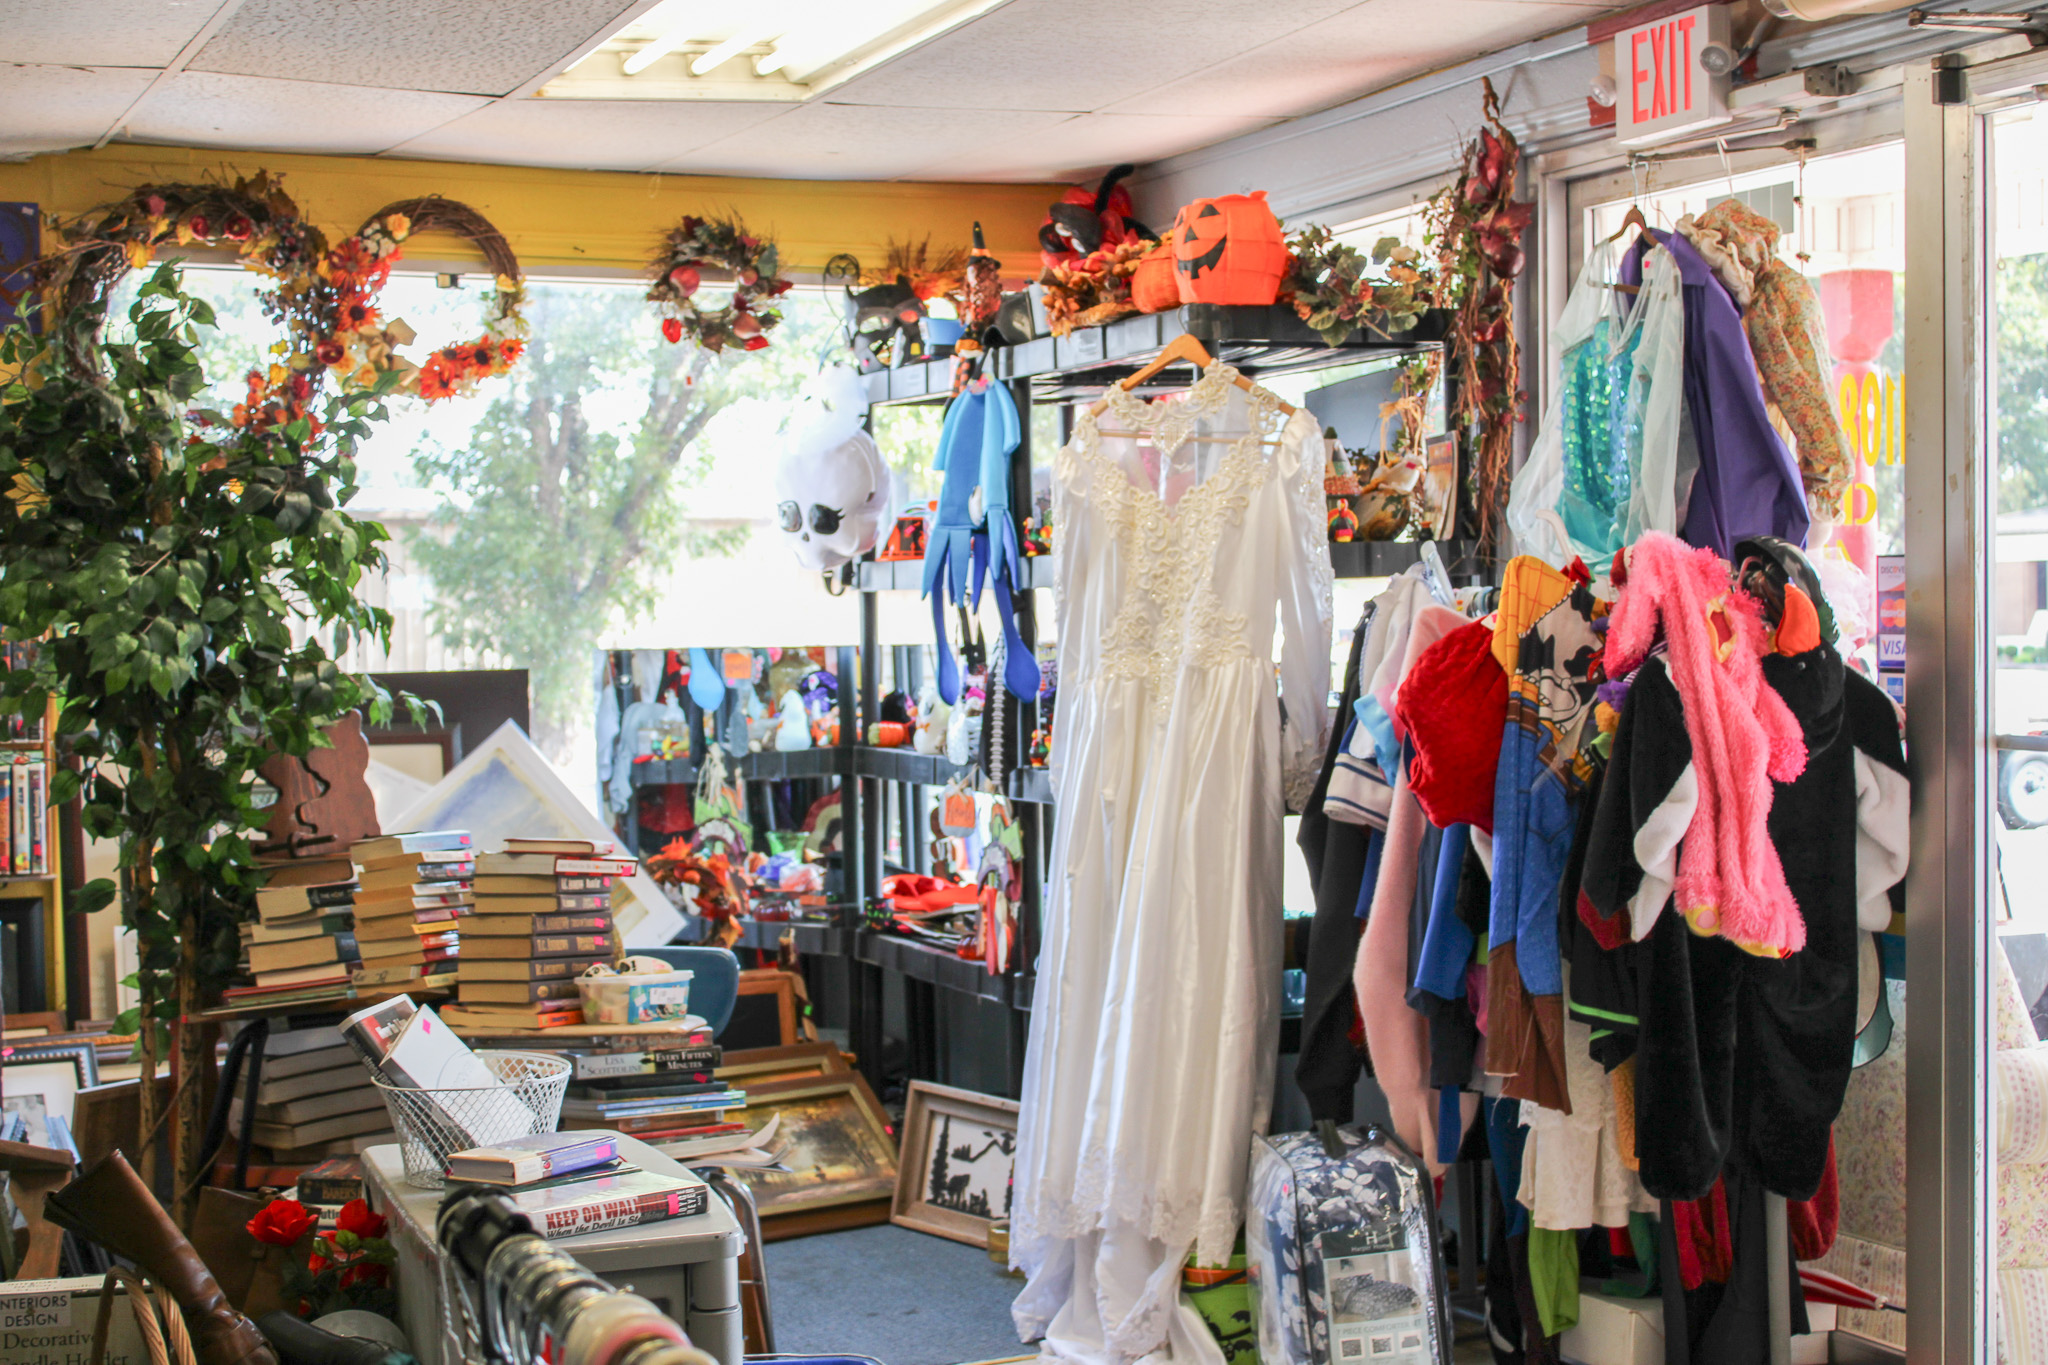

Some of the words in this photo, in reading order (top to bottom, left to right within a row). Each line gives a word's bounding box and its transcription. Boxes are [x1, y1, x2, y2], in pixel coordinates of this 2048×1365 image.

[1632, 15, 1696, 124] EXIT
[1880, 565, 1905, 574] DISCOVE
[655, 1053, 680, 1063] EVERY
[681, 1050, 713, 1061] FIFTEEN
[667, 1061, 703, 1070] MINUTES
[545, 1209, 579, 1230] KEEP
[582, 1204, 602, 1223] ON
[546, 1227, 572, 1239] When
[575, 1222, 590, 1234] the
[592, 1219, 616, 1231] Devil
[0, 1295, 68, 1311] NTERIORS
[5, 1313, 58, 1328] DESIGN
